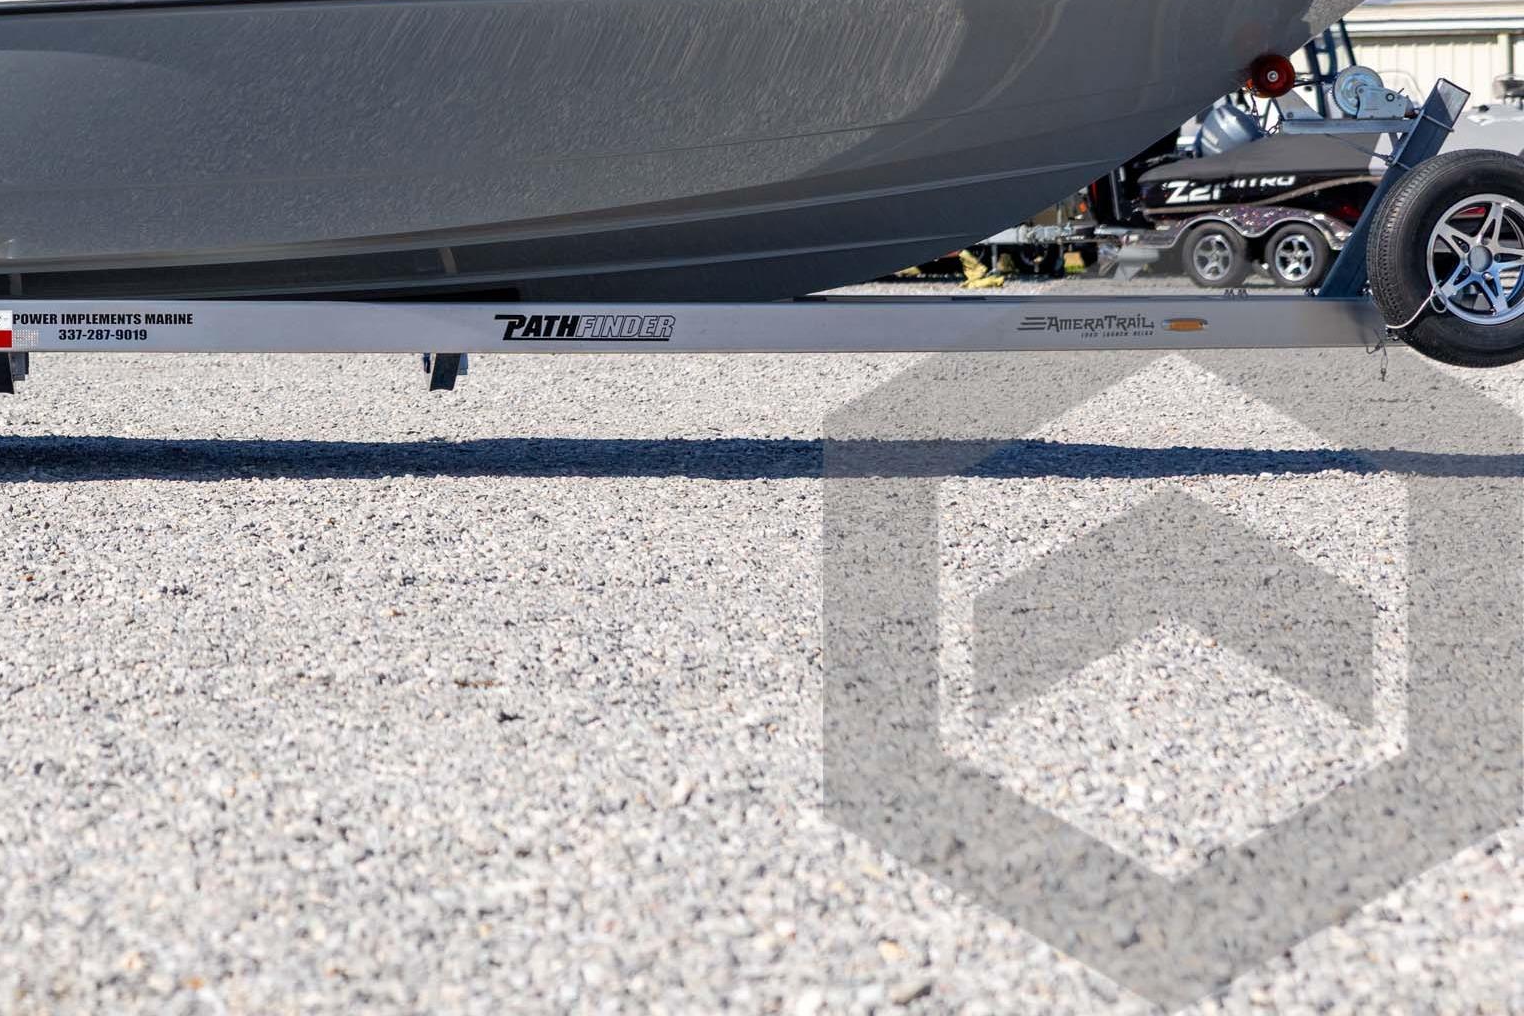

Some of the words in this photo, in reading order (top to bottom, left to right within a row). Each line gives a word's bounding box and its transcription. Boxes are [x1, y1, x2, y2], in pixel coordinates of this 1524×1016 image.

[12, 313, 58, 325] POWER
[61, 313, 142, 325] IMPLEMENTS
[144, 313, 194, 325] MARINE
[494, 314, 677, 341] PATHFINDER
[58, 329, 148, 341] 337-287-9019
